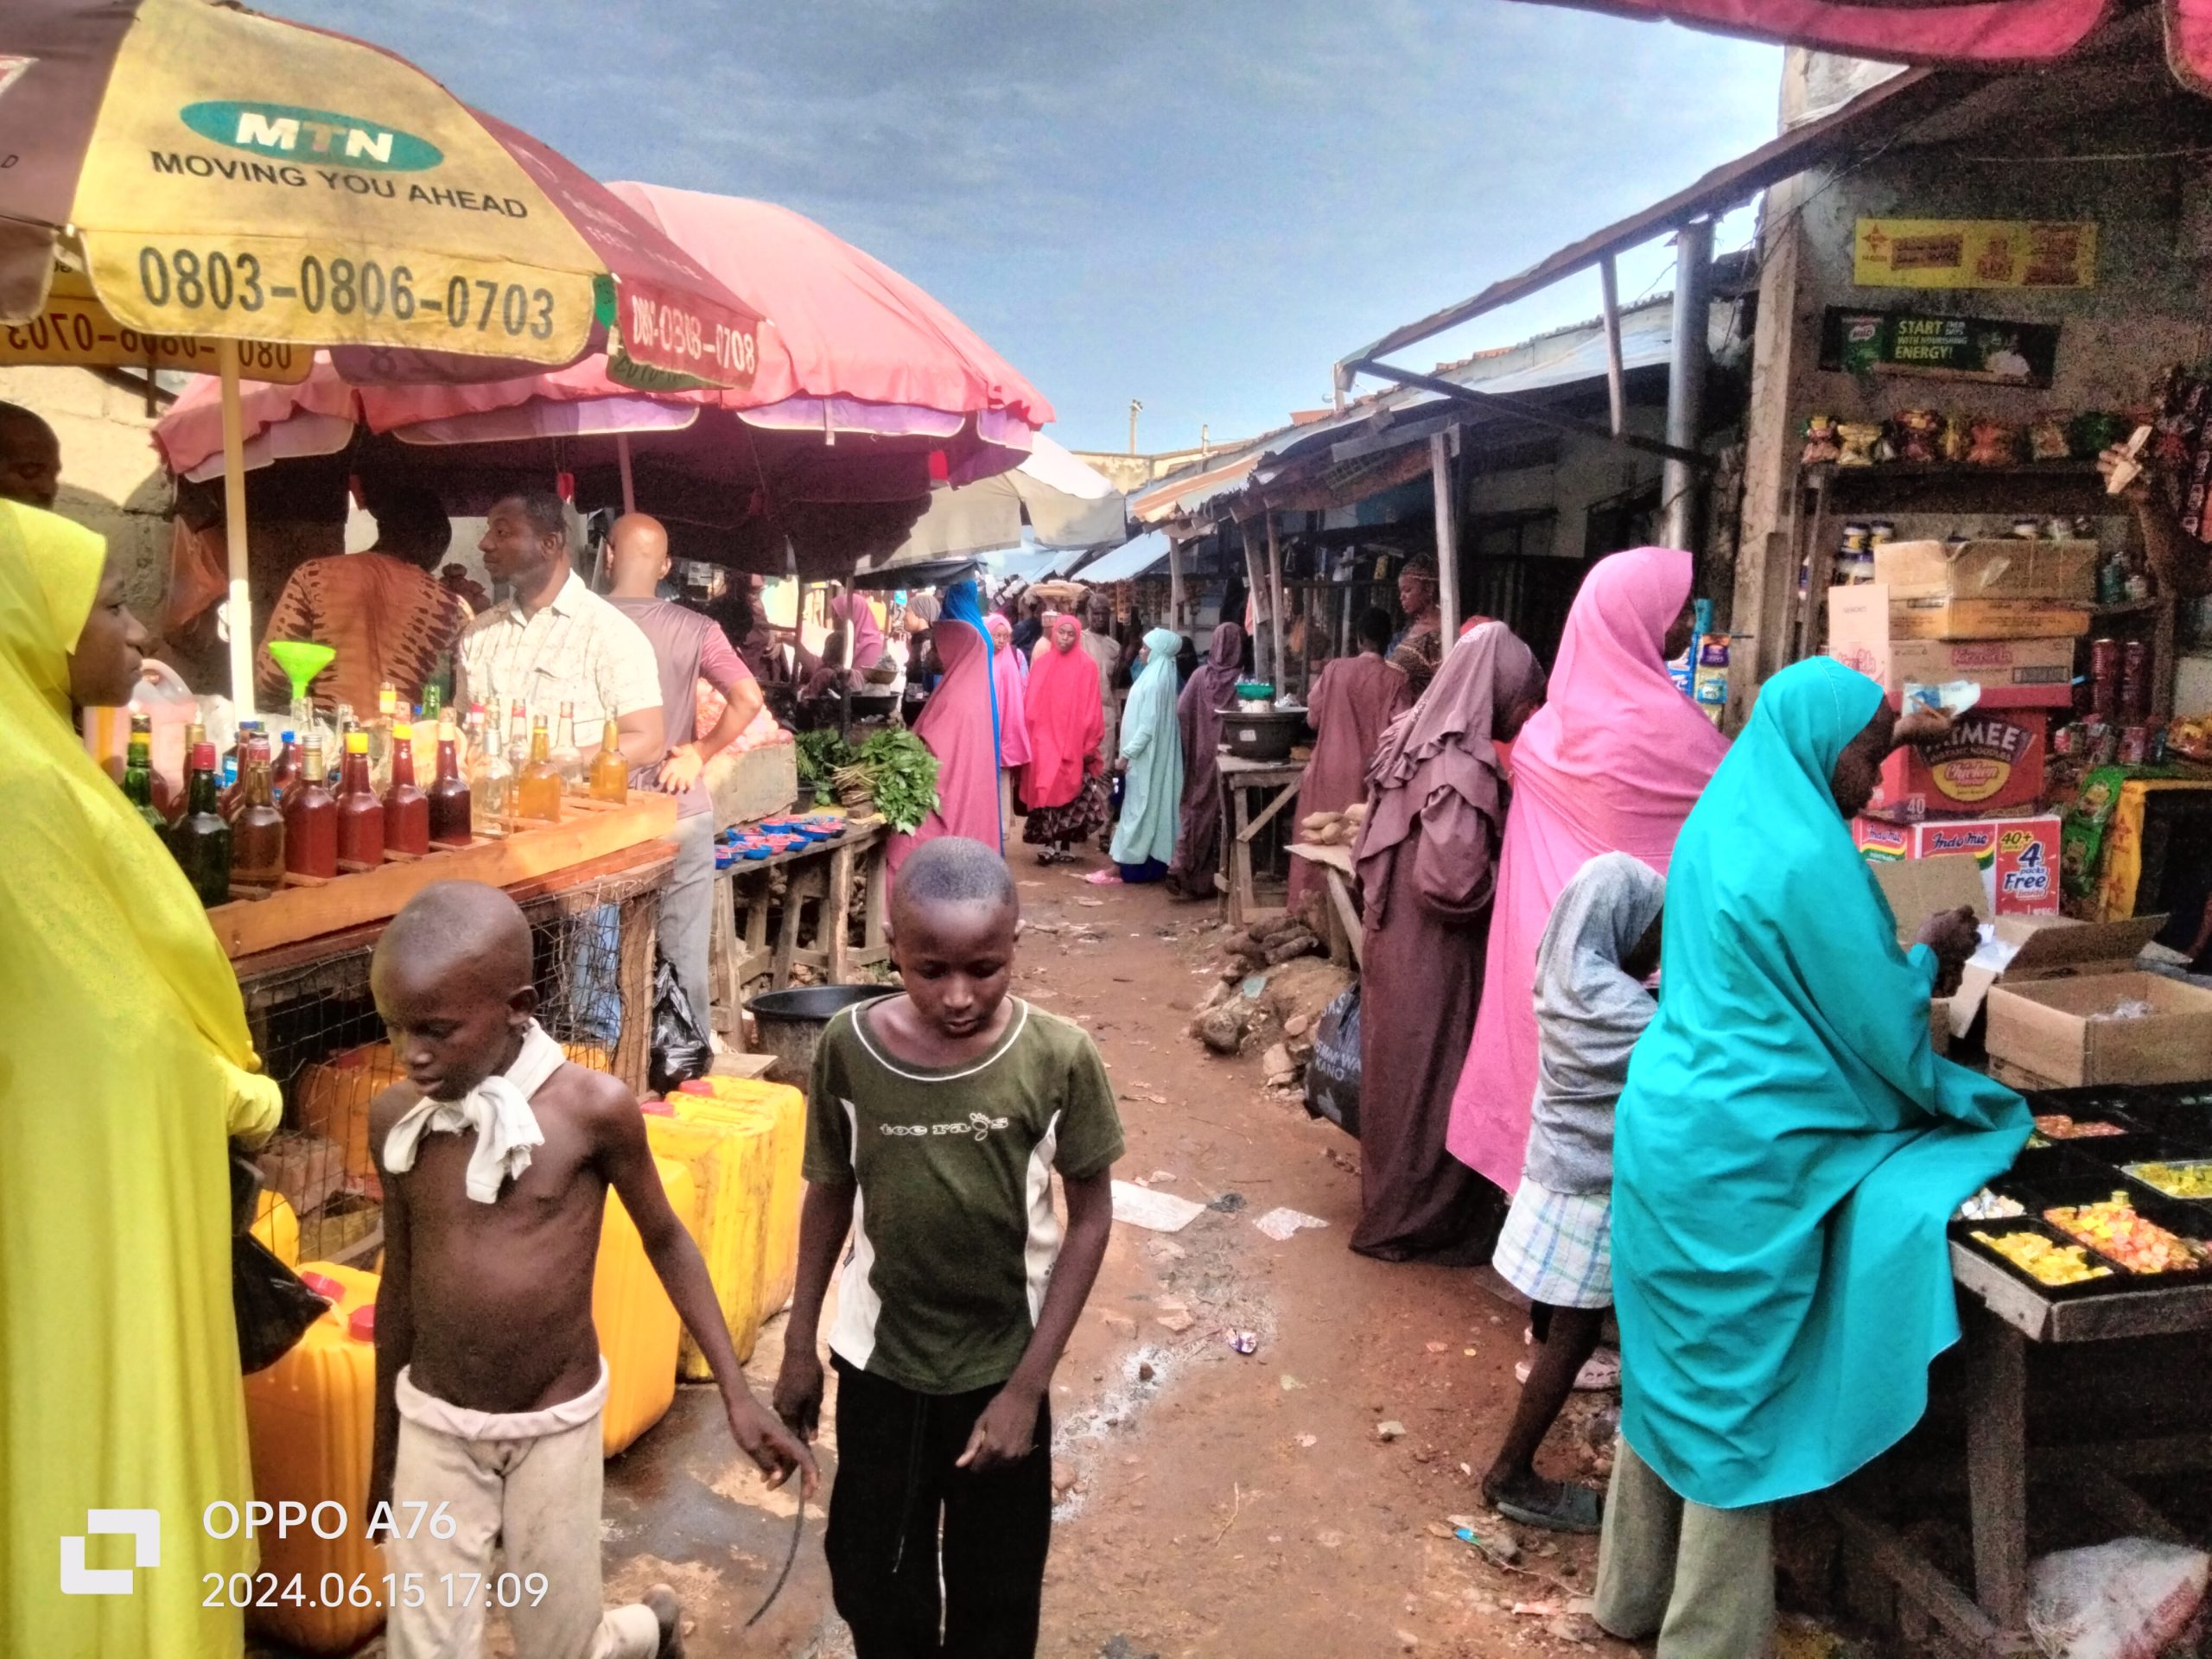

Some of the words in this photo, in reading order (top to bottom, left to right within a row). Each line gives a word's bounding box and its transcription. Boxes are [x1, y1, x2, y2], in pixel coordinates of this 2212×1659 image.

[236, 112, 393, 163] MTN
[150, 150, 307, 187] MOVING
[316, 169, 396, 199] YOU
[408, 184, 528, 218] AHEAD
[138, 245, 555, 340] 0803-0806-0703
[1898, 321, 1943, 334] START
[1895, 346, 1954, 359] ENERGY!
[1907, 798, 1926, 815] 40
[2001, 832, 2032, 845] 40+
[2018, 842, 2040, 868] 4
[2004, 873, 2046, 890] Free
